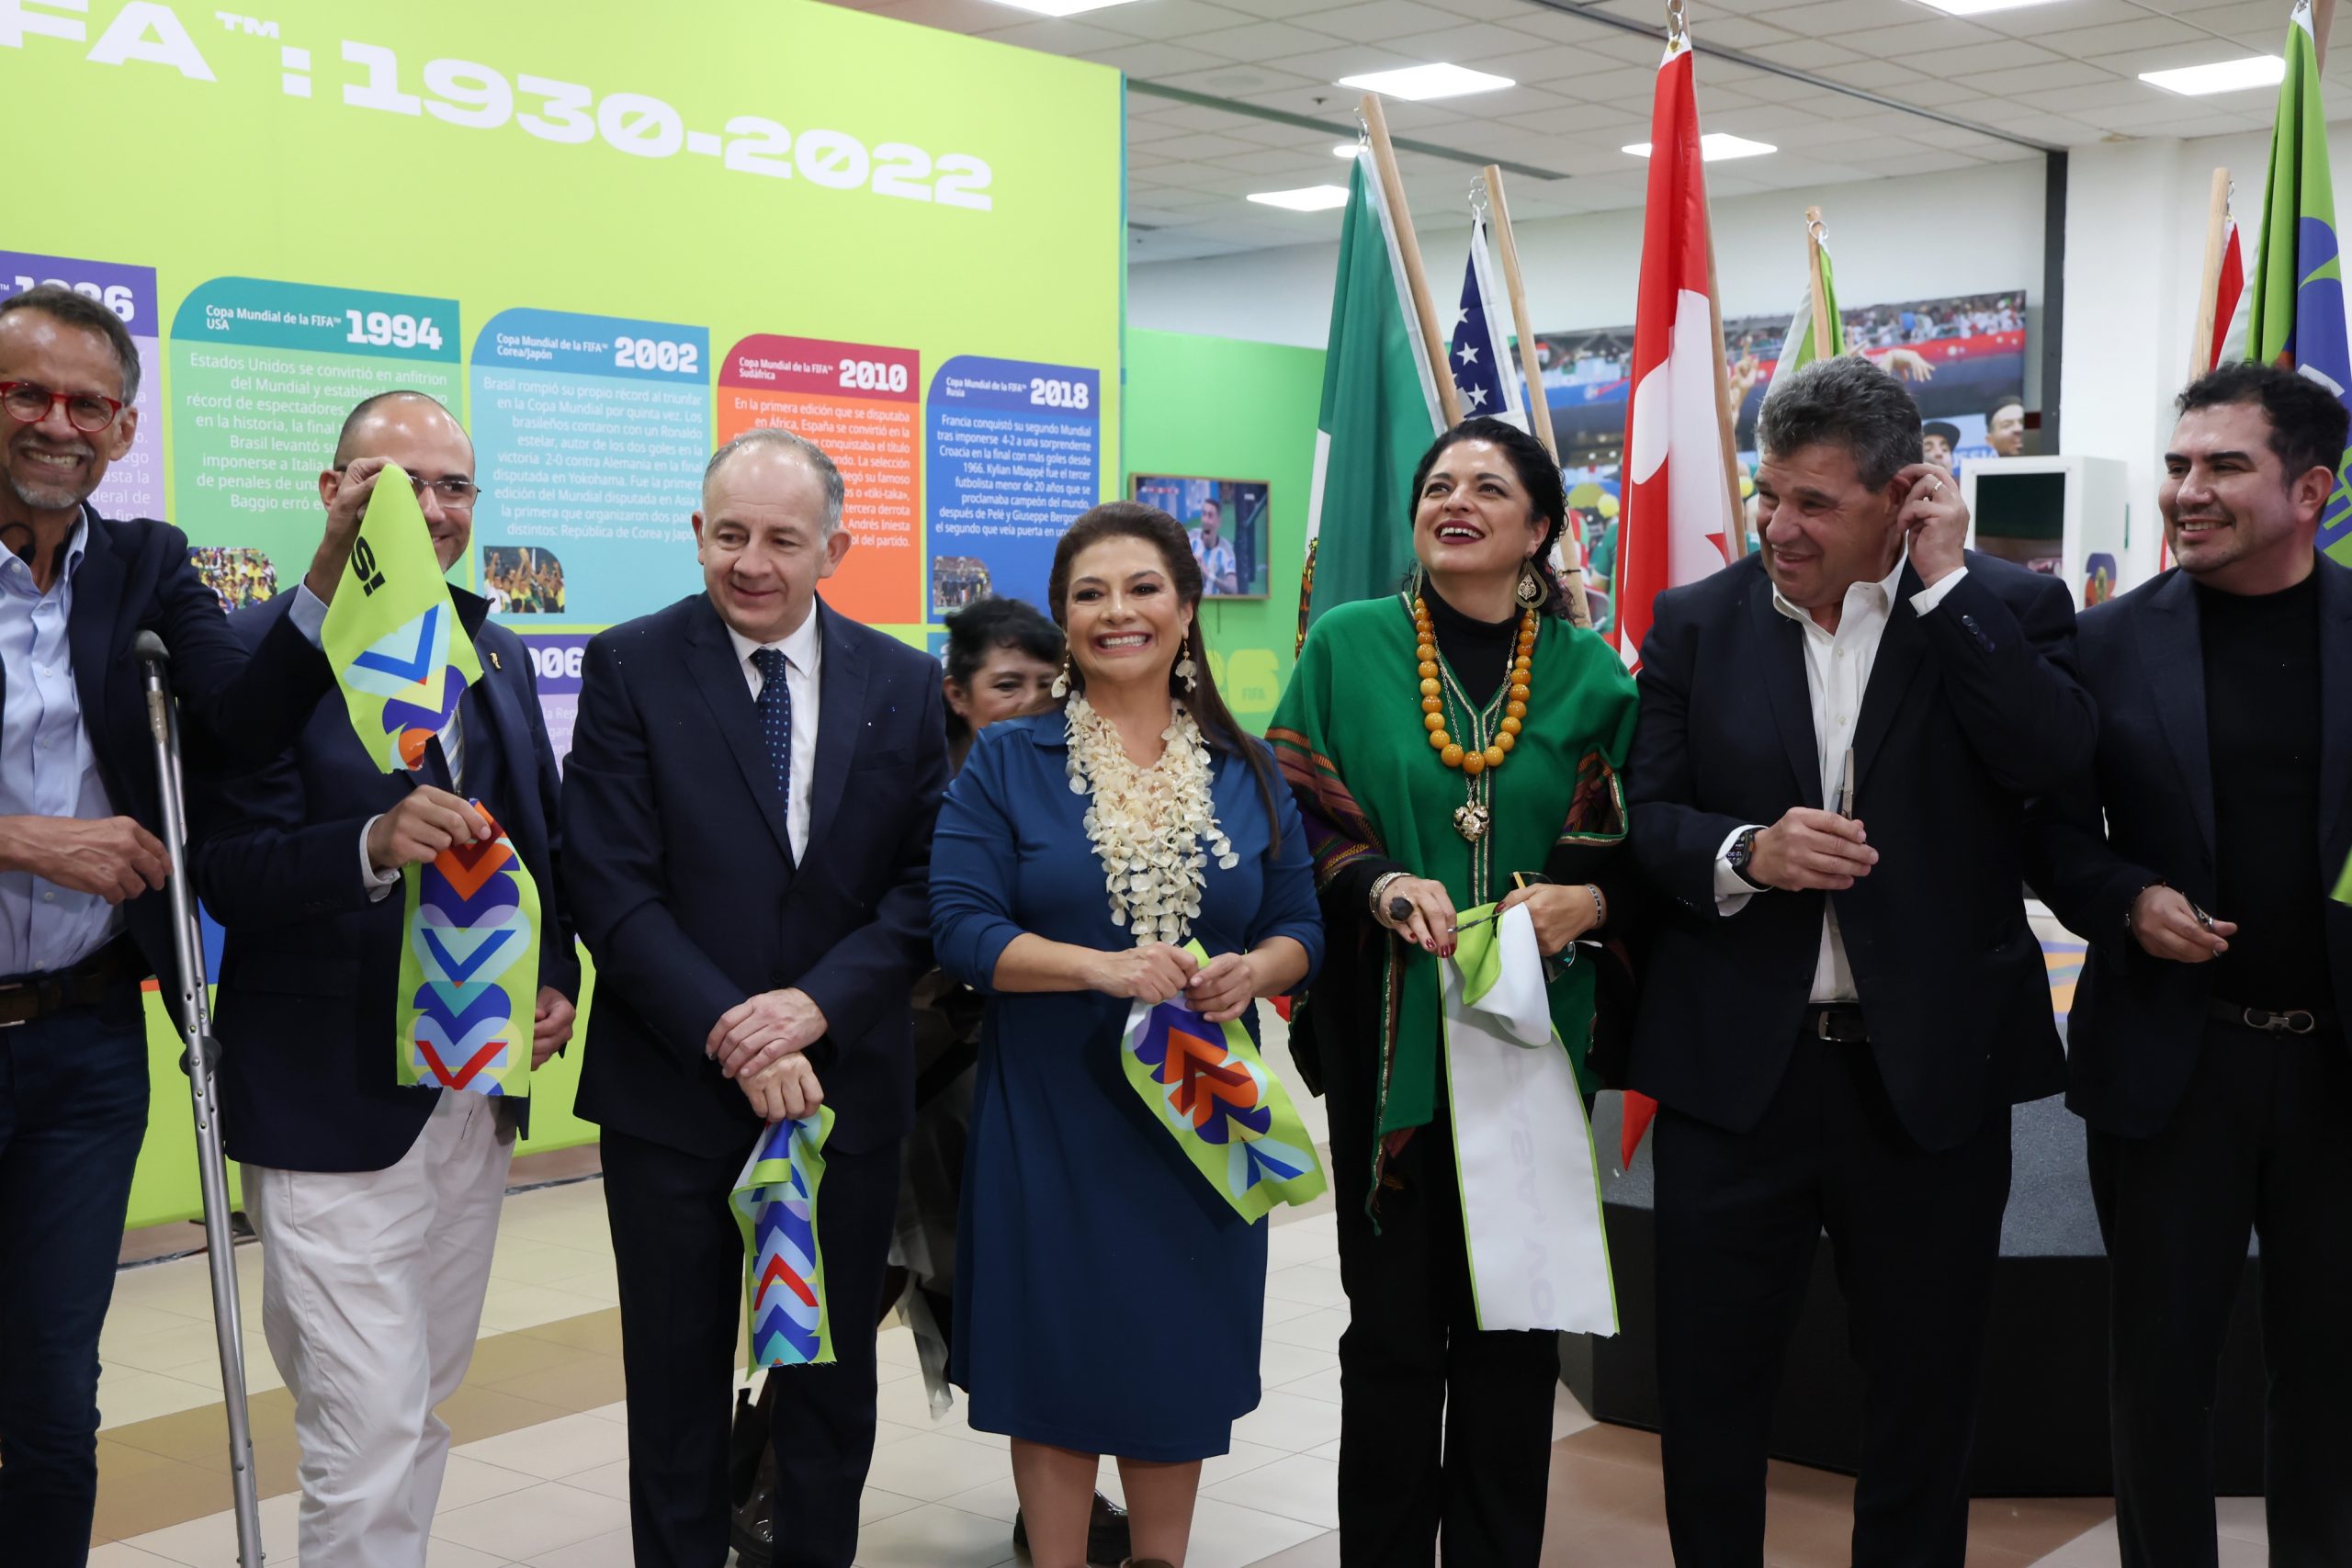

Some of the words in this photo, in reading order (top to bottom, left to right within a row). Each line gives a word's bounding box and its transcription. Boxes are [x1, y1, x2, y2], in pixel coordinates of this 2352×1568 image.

[342, 39, 992, 211] 1930-2022
[206, 305, 233, 321] Copa
[236, 308, 280, 322] Mundial
[283, 310, 296, 323] de
[299, 312, 308, 324] la
[311, 313, 341, 327] FIFA™
[206, 318, 230, 331] USA
[346, 309, 443, 350] 1994
[496, 333, 520, 347] Copa
[521, 336, 558, 349] Mundial
[559, 338, 571, 350] de
[572, 340, 581, 351] la
[615, 337, 698, 374] 2002
[190, 352, 244, 369] Estados
[248, 357, 295, 373] Unidos
[299, 364, 313, 375] se
[317, 364, 372, 379] convirtió
[375, 370, 391, 381] en
[839, 359, 908, 393] 2010
[230, 375, 251, 390] del
[255, 378, 309, 394] Mundial
[313, 384, 320, 398] y
[323, 383, 383, 399] estableci
[483, 377, 515, 391] Brasil
[561, 385, 574, 396] su
[577, 385, 612, 401] propio
[651, 389, 661, 402] al
[663, 390, 703, 405] triunfar
[1030, 378, 1089, 410] 2018
[186, 393, 231, 409] récord
[235, 395, 252, 410] de
[497, 399, 511, 409] en
[514, 396, 524, 410] la
[527, 398, 555, 415] Copa
[558, 401, 603, 416] Mundial
[605, 407, 623, 420] por
[626, 406, 660, 422] quinta
[685, 409, 703, 423] Los
[735, 398, 747, 410] En
[749, 398, 758, 411] la
[760, 400, 797, 414] primera
[834, 408, 852, 420] que
[854, 409, 864, 419] se
[866, 407, 910, 423] disputaba
[195, 416, 213, 427] en
[217, 413, 229, 428] la
[292, 418, 303, 432] la
[307, 419, 335, 434] final
[571, 421, 620, 435] contaron
[623, 425, 642, 436] con
[644, 426, 658, 437] un
[660, 425, 703, 440] Ronaldo
[755, 418, 767, 428] en
[836, 424, 846, 433] se
[888, 428, 900, 437] en
[901, 425, 910, 438] la
[230, 434, 267, 449] Brasil
[271, 436, 319, 452] levantó
[560, 438, 589, 451] autor
[593, 438, 606, 452] de
[609, 438, 624, 453] los
[627, 439, 646, 454] dos
[648, 441, 676, 457] goles
[678, 445, 691, 456] en
[693, 443, 703, 457] la
[820, 437, 875, 451] conquistaba
[877, 439, 885, 451] el
[202, 453, 276, 471] imponerse
[280, 459, 287, 470] a
[292, 456, 323, 471] Italia
[498, 451, 539, 465] victoria
[546, 453, 563, 466] 2-0
[565, 455, 600, 468] contra
[602, 455, 651, 470] Alemania
[653, 460, 667, 471] en
[669, 458, 678, 471] la
[681, 458, 703, 473] final
[857, 454, 868, 466] La
[102, 470, 132, 483] asta
[137, 469, 150, 484] la
[197, 472, 214, 486] de
[218, 474, 271, 491] penales
[275, 475, 291, 490] de
[92, 490, 128, 503] deral
[132, 490, 151, 504] de
[230, 494, 278, 512] Baggio
[282, 495, 309, 510] erró
[845, 503, 876, 514] tercera
[877, 502, 911, 516] derrota
[881, 519, 911, 531] Iniesta
